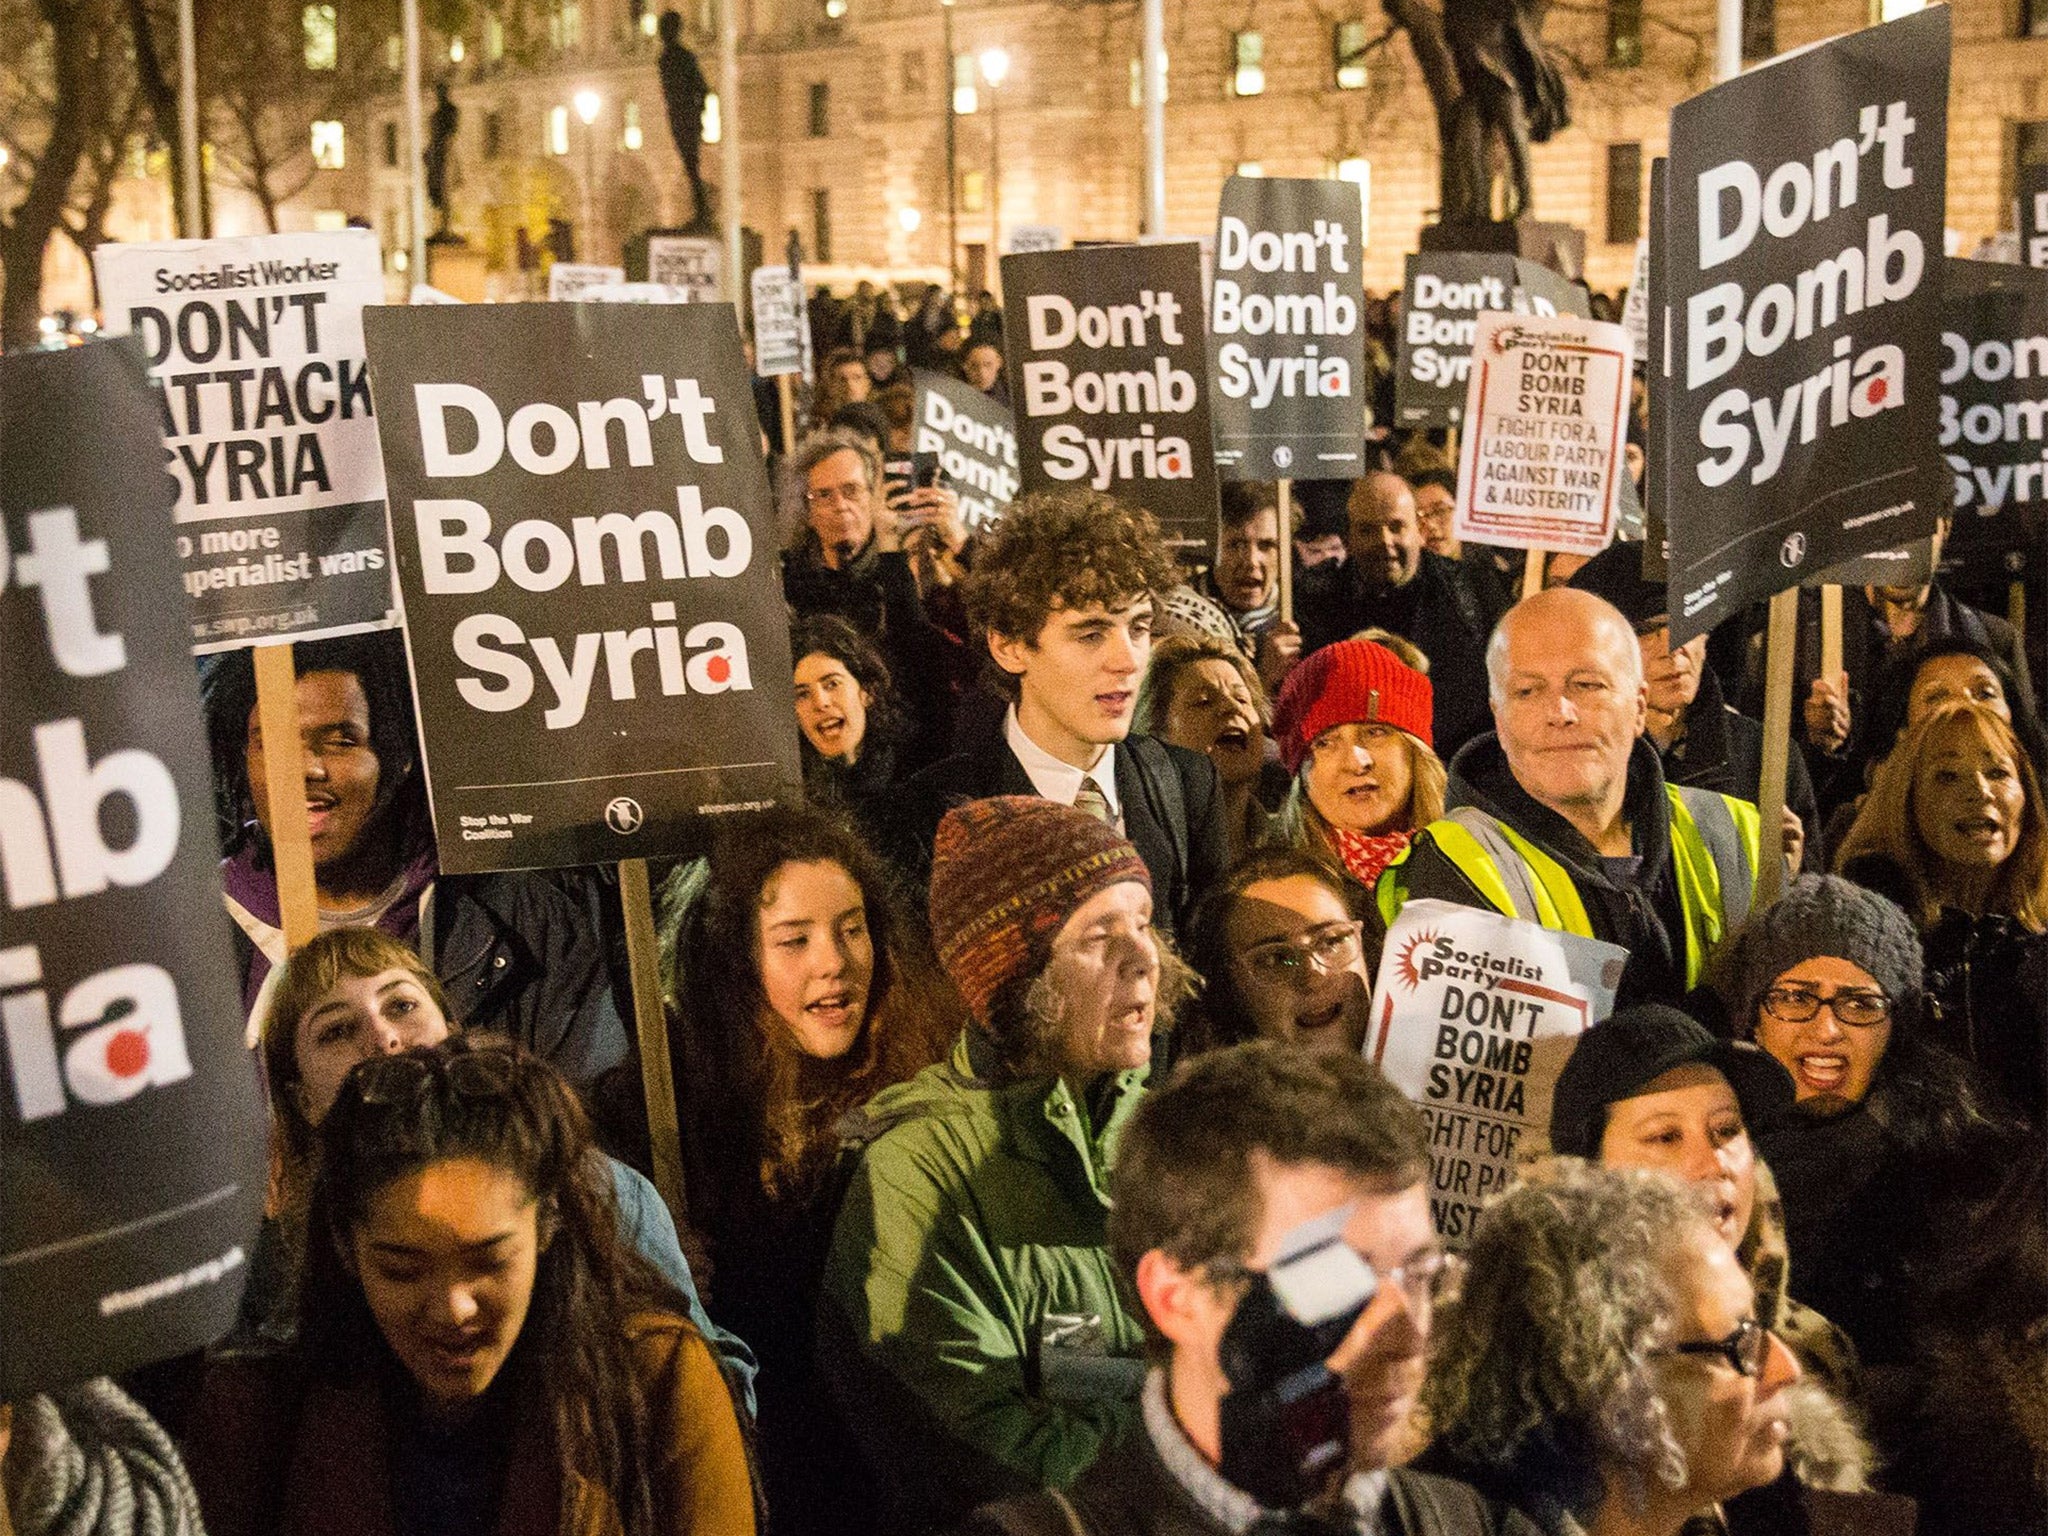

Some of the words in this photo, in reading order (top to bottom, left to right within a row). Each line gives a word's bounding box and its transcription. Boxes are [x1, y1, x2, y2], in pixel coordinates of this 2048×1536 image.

[1698, 101, 1915, 270] Don't
[1219, 216, 1349, 273] Don't
[155, 262, 258, 294] Socialist
[259, 256, 339, 286] Worker
[1413, 273, 1505, 309] Don't
[1026, 289, 1184, 351] Don't
[1213, 279, 1357, 336] Bomb
[1687, 213, 1924, 390] Bomb
[129, 292, 327, 367] DON'T
[1406, 310, 1478, 346] Bom
[1219, 342, 1350, 409] Syria
[1410, 346, 1472, 389] Syr
[1521, 352, 1589, 374] DON'T
[1521, 373, 1586, 395] BOMB
[1940, 332, 2048, 385] Don
[1022, 356, 1197, 417] Bomb
[1517, 394, 1583, 417] SYRIA
[1697, 336, 1904, 487] Syria
[413, 374, 723, 477] Don't
[924, 390, 1019, 468] Don't
[1498, 417, 1545, 439] FIGHT
[1550, 421, 1582, 442] FOR
[1587, 425, 1597, 443] A
[1938, 394, 2048, 446] om
[1042, 424, 1193, 491] Syria
[1482, 440, 1549, 461] LABOUR
[1553, 446, 1608, 467] PARTY
[1482, 461, 1558, 486] AGAINST
[1563, 468, 1601, 489] WAR
[1485, 485, 1497, 504] &
[1502, 486, 1594, 512] AUSTERITY
[1945, 449, 2048, 517] Syr
[200, 526, 281, 555] more
[413, 485, 753, 595] Bomb
[183, 551, 313, 598] perialist
[318, 546, 385, 578] wars
[452, 601, 754, 730] Syria
[460, 815, 487, 828] Stop
[489, 815, 508, 826] the
[511, 813, 533, 825] War
[462, 828, 513, 841] Coalition
[1419, 958, 1501, 991] Party
[1432, 937, 1544, 983] Socialist
[1441, 986, 1545, 1038] DON'T
[1434, 1024, 1534, 1076] BOMB
[1425, 1063, 1526, 1116] SYRIA
[1422, 1109, 1470, 1150] GHT
